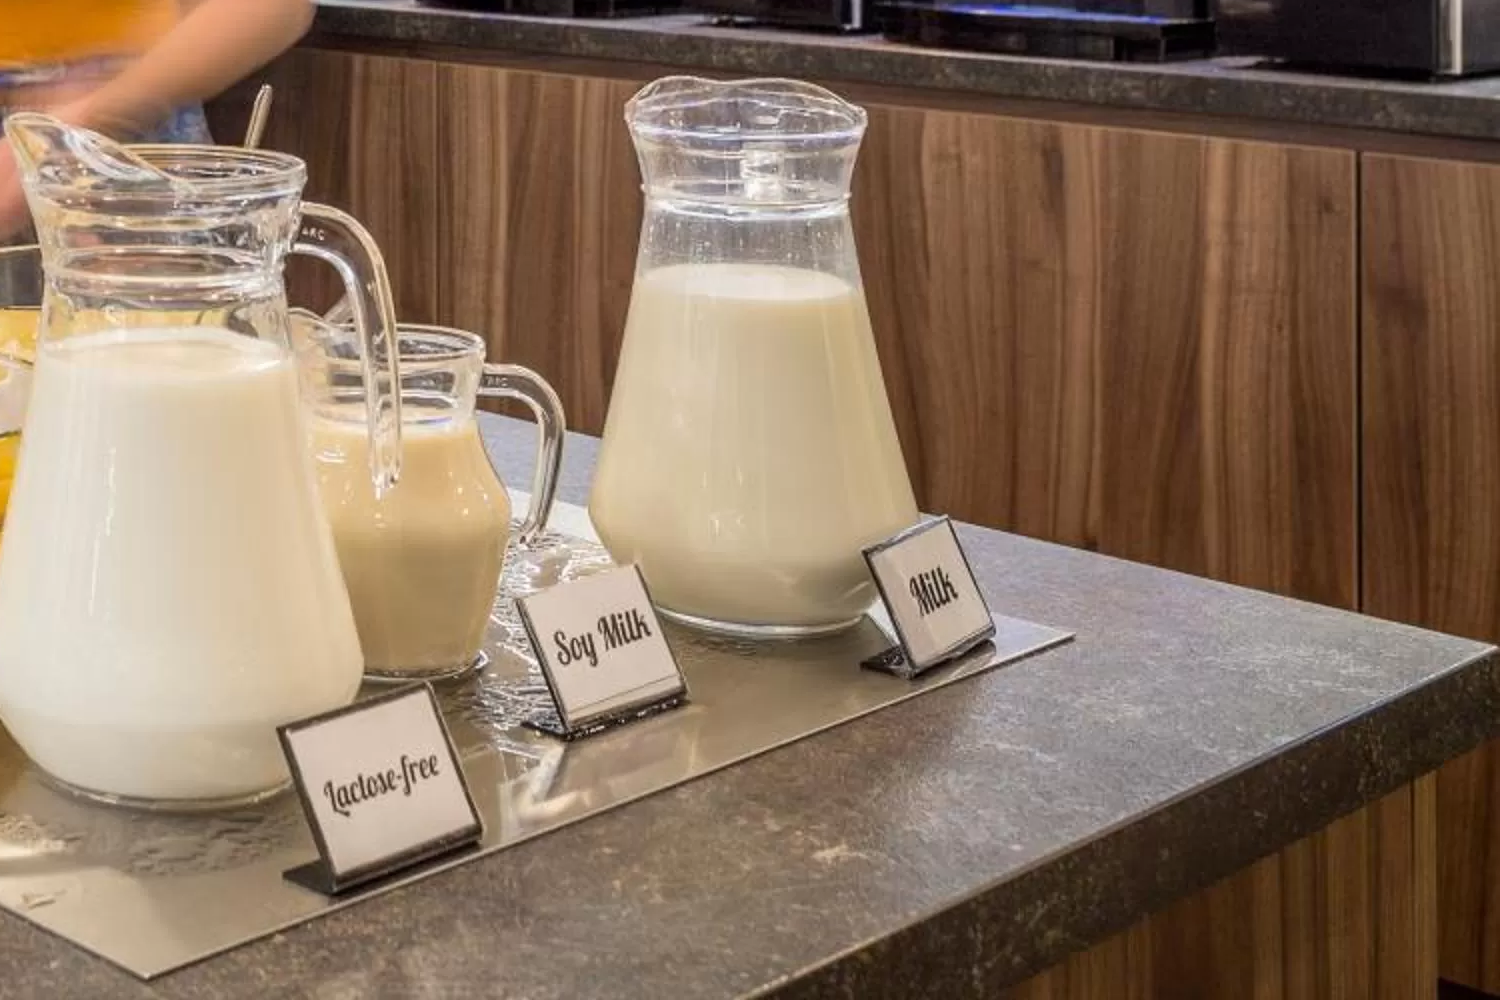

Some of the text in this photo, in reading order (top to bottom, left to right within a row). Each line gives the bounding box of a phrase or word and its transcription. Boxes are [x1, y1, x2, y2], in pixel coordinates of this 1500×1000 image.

[909, 565, 959, 617] Milk
[553, 607, 652, 668] Soy Milk
[323, 753, 441, 818] Lactose-free
